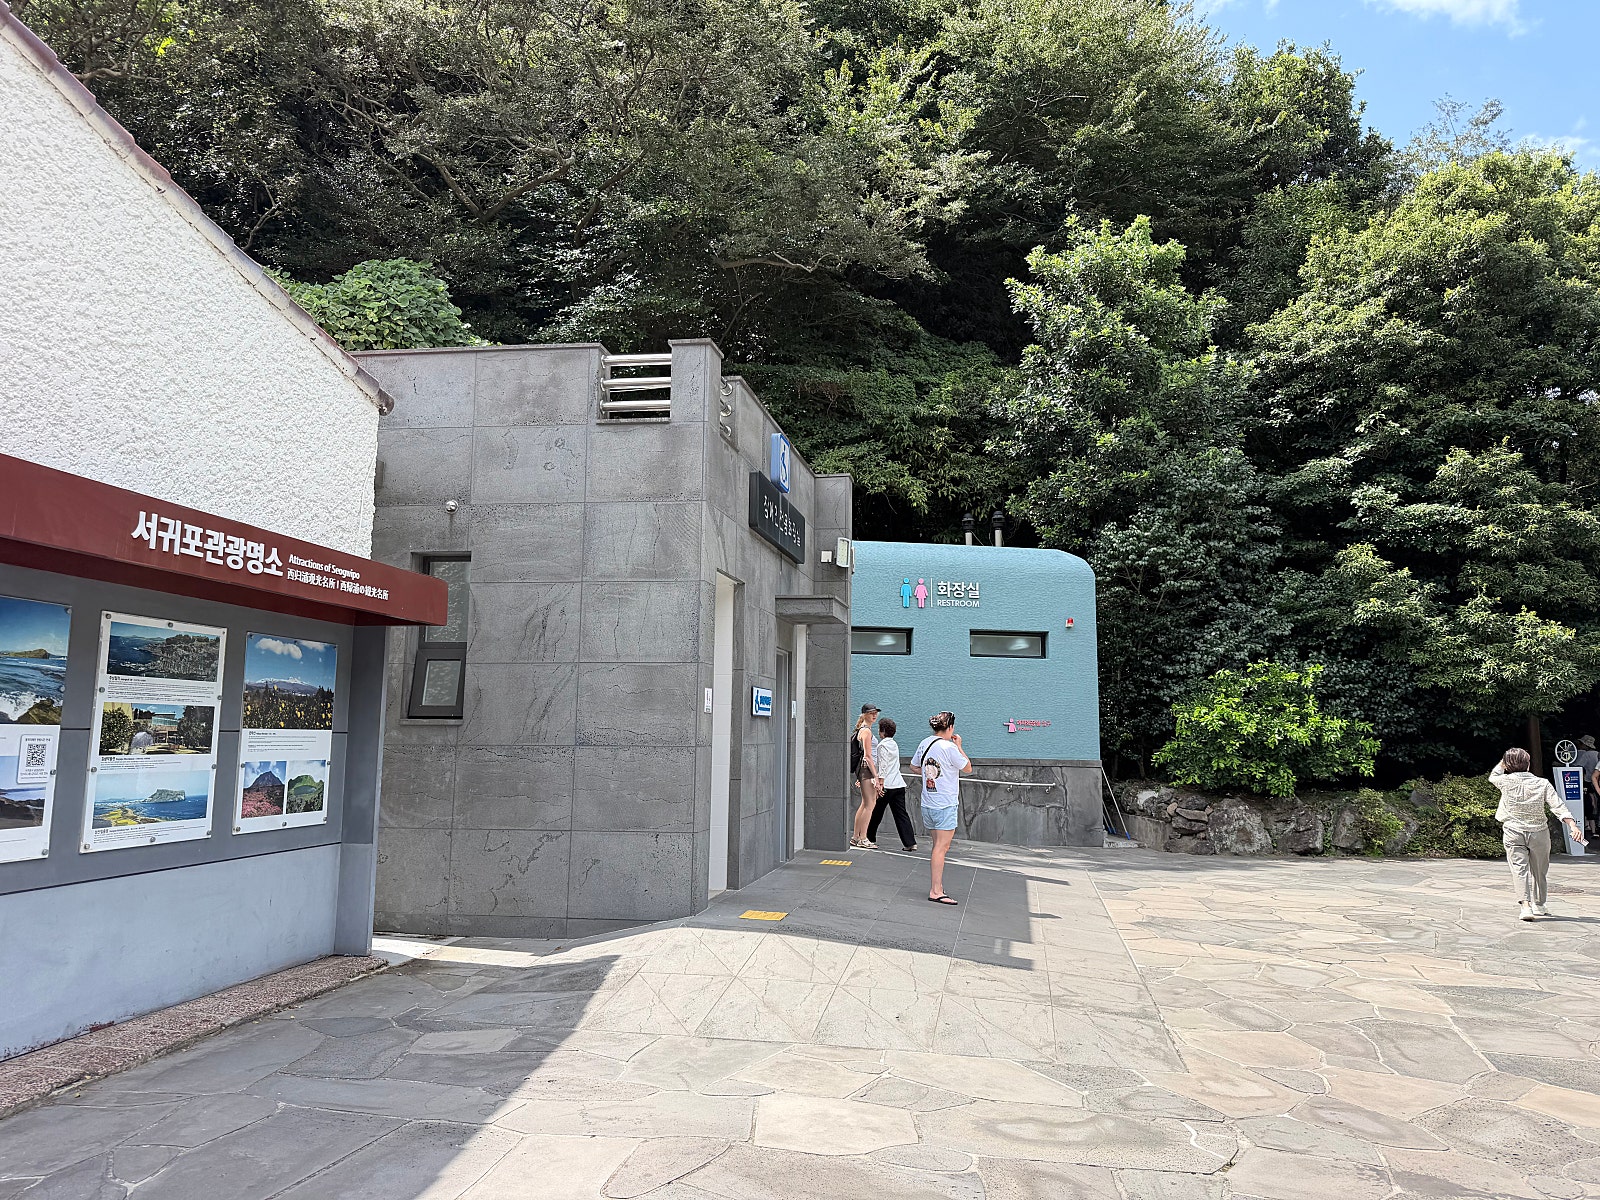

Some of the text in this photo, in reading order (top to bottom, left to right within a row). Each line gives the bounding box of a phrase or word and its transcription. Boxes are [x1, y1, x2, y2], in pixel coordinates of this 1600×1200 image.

[131, 510, 284, 577] 서귀포관광명소
[288, 553, 361, 581] Attractions of Seogwipo
[937, 580, 980, 599] 화장실
[937, 599, 980, 608] RESTROOM
